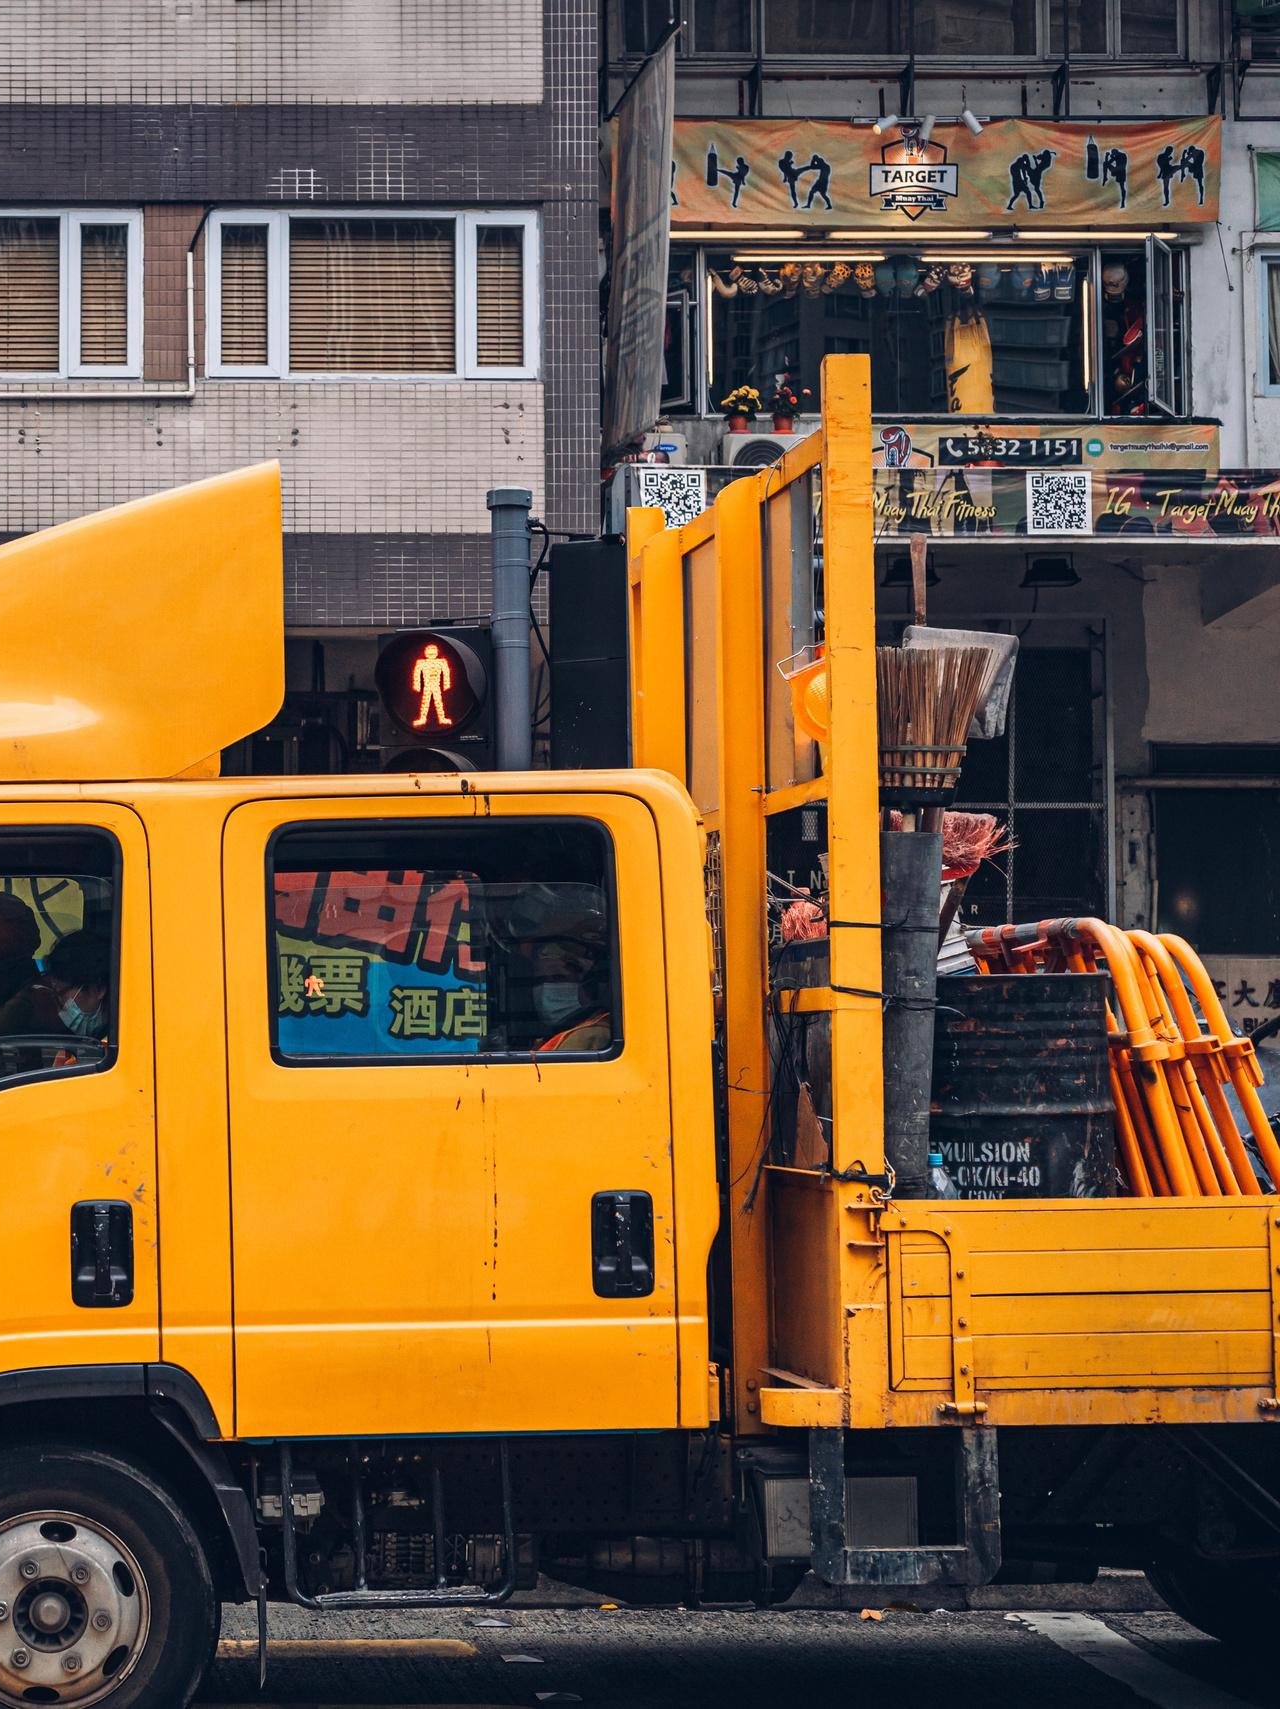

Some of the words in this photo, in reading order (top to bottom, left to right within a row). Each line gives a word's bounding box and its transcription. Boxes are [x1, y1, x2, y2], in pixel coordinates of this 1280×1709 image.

[882, 170, 948, 183] TARGET
[895, 195, 916, 203] Muay
[968, 439, 1020, 456] 532
[1030, 439, 1078, 456] 1151
[873, 491, 907, 524] Muay
[907, 490, 942, 519] Thai
[943, 489, 997, 521] Fitness
[1102, 486, 1136, 516] IG
[1156, 488, 1217, 525] Target
[1215, 488, 1259, 524] Muay
[391, 988, 487, 1037] 酒店
